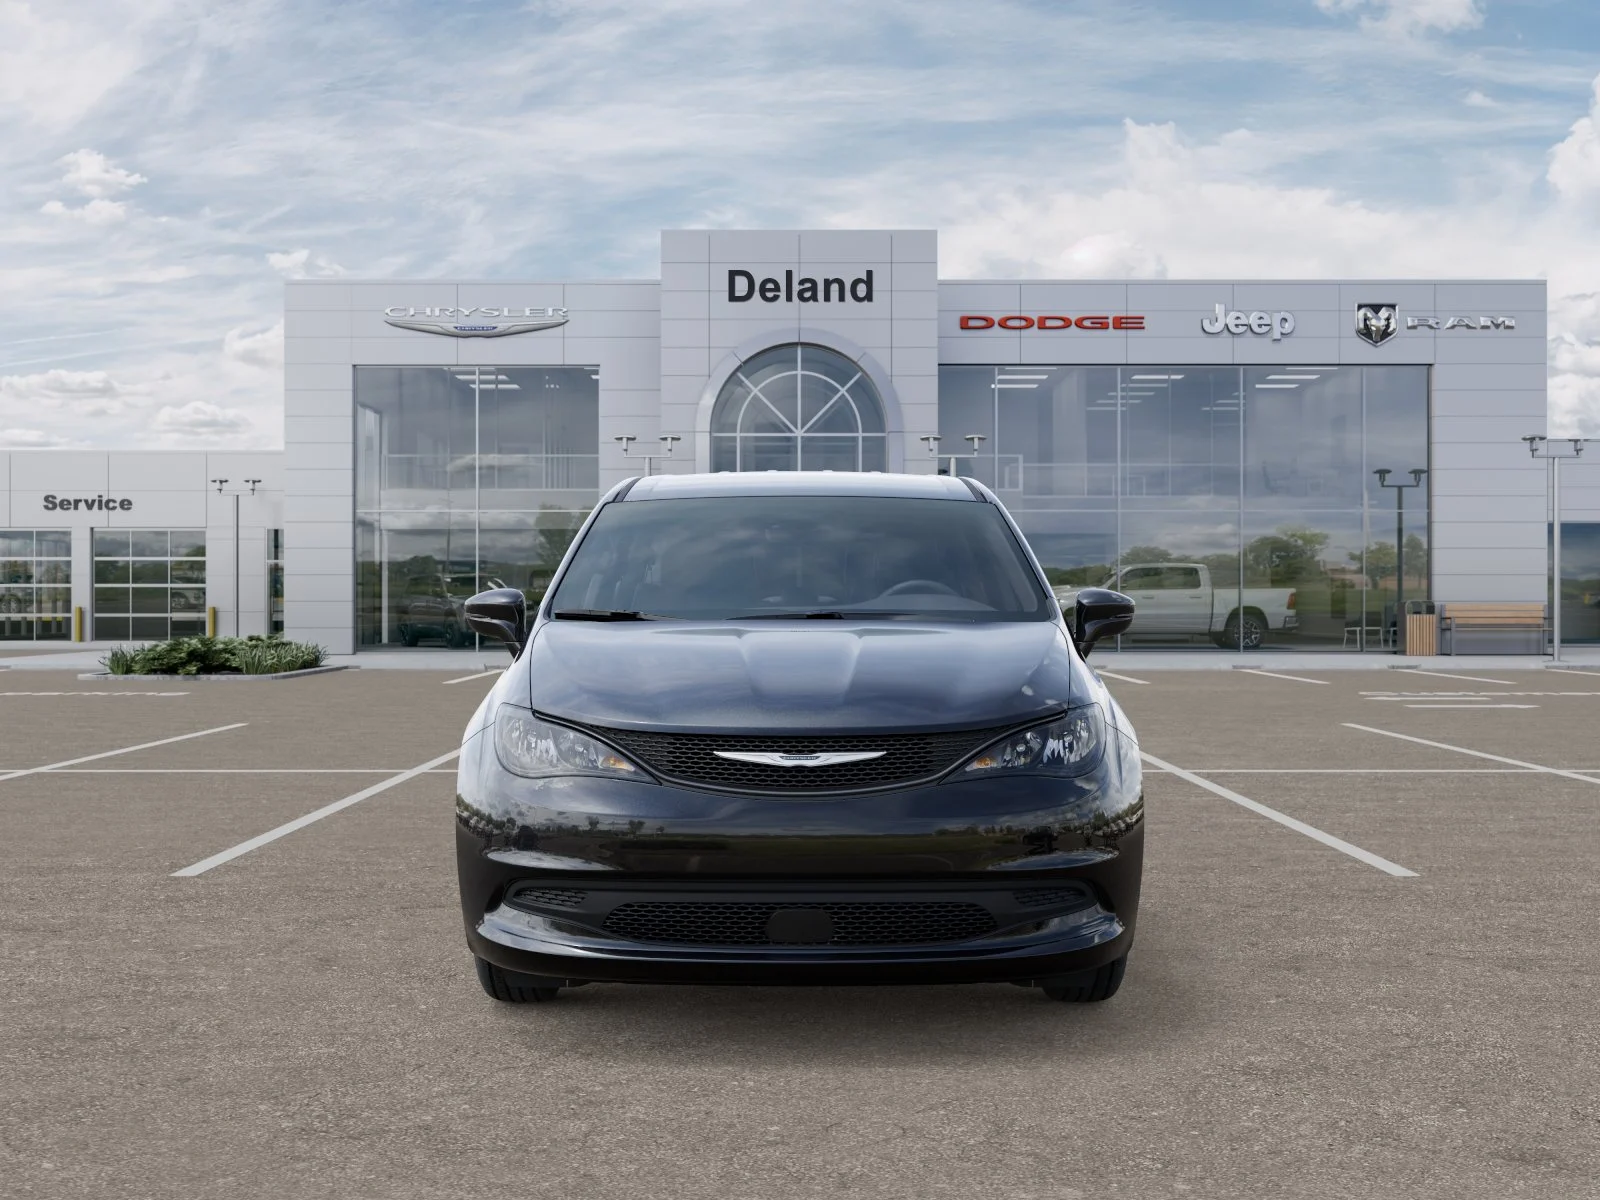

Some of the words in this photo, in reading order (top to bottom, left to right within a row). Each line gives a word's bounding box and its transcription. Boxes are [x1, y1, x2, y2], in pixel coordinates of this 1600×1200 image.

[728, 269, 874, 303] Deland
[384, 306, 570, 318] CHRYSLER
[959, 315, 1146, 330] DODGE
[1201, 303, 1296, 342] Jeep
[1406, 316, 1516, 330] RAM
[42, 494, 133, 511] Service
